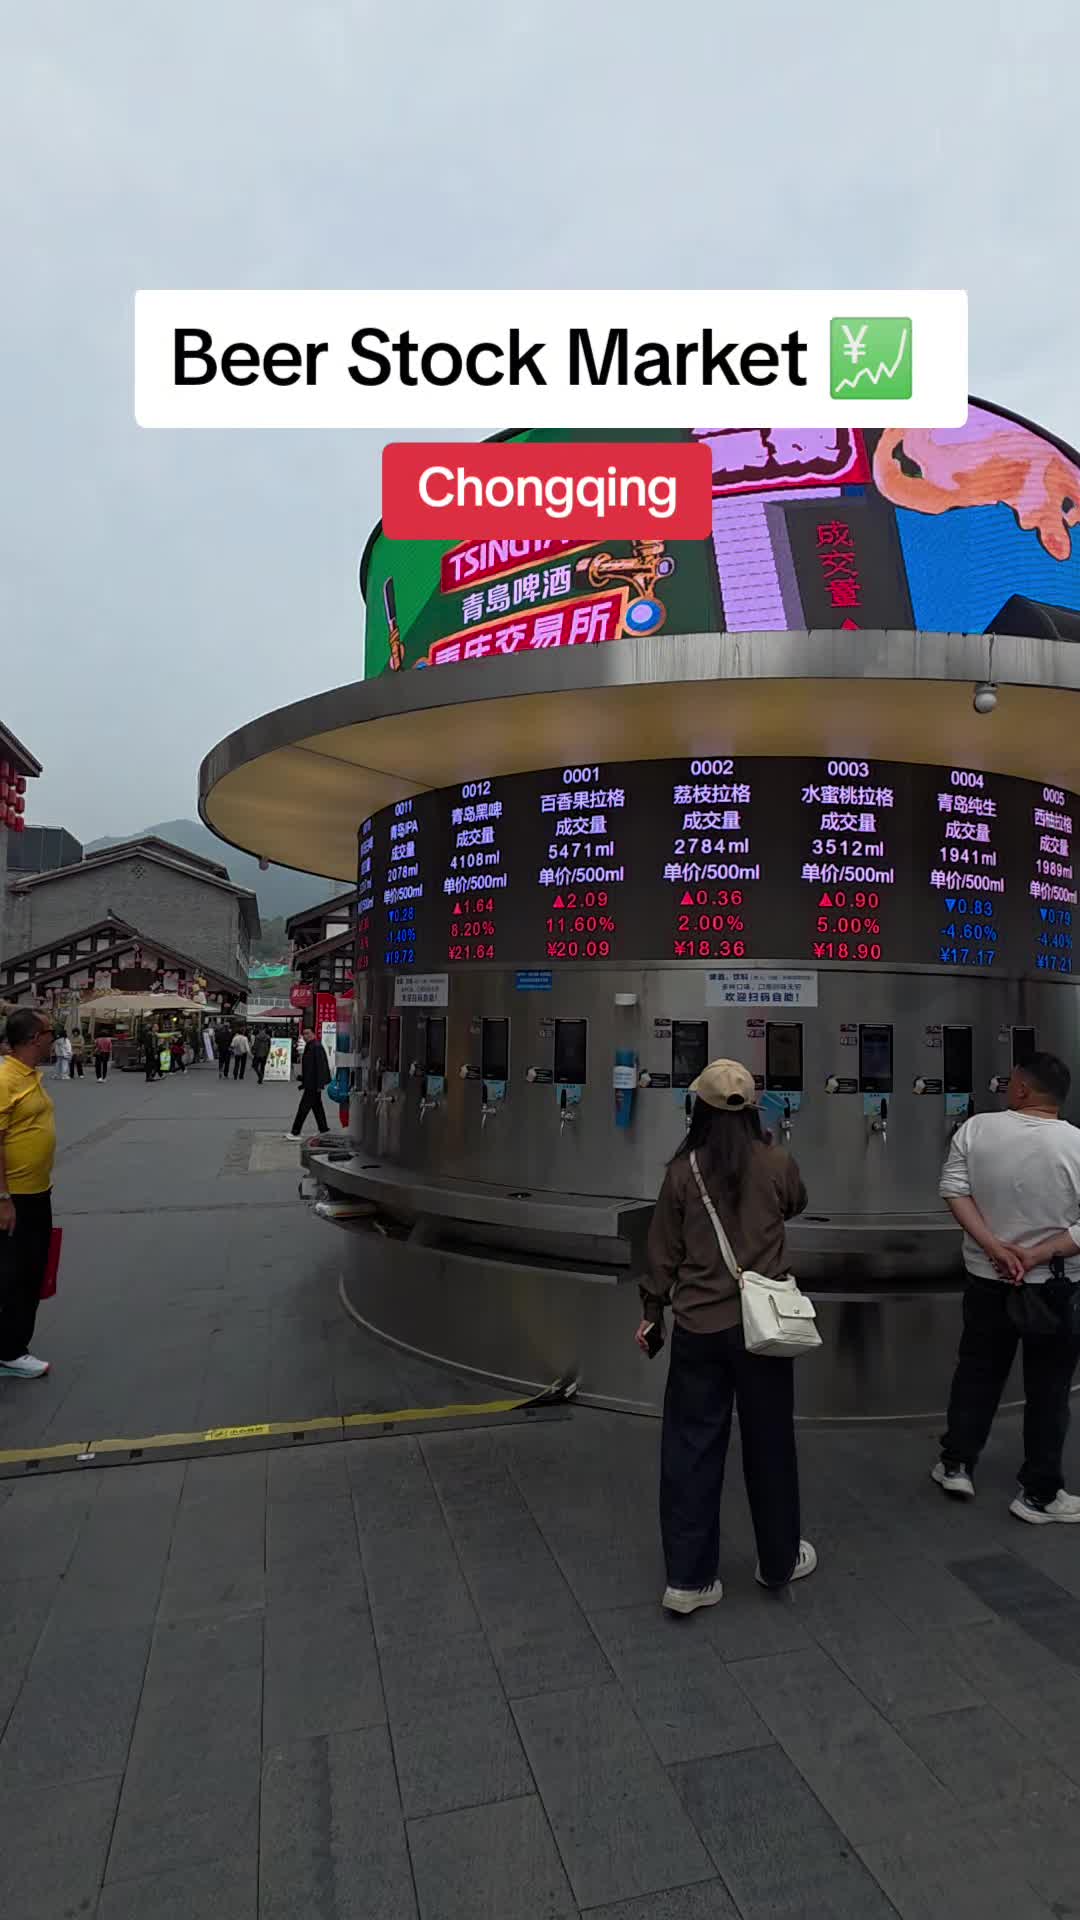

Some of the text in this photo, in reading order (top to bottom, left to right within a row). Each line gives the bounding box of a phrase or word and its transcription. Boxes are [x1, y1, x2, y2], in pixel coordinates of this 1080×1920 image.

[816, 520, 862, 607] 成交量
[462, 564, 571, 624] 青島啤酒
[563, 767, 598, 784] 0001
[691, 760, 733, 776] 0002
[828, 761, 869, 777] 0003
[951, 771, 984, 788] 0004
[461, 781, 490, 798] 0012
[674, 784, 750, 804] 荔枝拉格
[801, 786, 893, 807] 水蜜桃拉格
[1043, 786, 1066, 806] 0005
[395, 801, 412, 816] 0011
[540, 788, 625, 812] 百香果拉格
[937, 793, 996, 817] 青岛纯生
[452, 801, 502, 825] 青岛黑啤
[683, 811, 740, 830] 成交量
[820, 812, 876, 832] 成交量
[556, 815, 607, 836] 成交量
[945, 821, 990, 842] 成交量
[456, 826, 495, 847] 成交量
[1040, 835, 1068, 856] 成交量
[391, 841, 415, 860] 成交量
[549, 841, 614, 859] 5471ml
[675, 838, 748, 854] 2784ml
[813, 839, 883, 856] 3512ml
[450, 851, 499, 869] 4108ml
[940, 847, 996, 866] 1941ml
[388, 863, 418, 882] 2078ml
[539, 866, 624, 886] 单价/500ml
[663, 863, 759, 882] 单价/500ml
[801, 863, 893, 883] 单价/500ml
[1036, 859, 1072, 879] 1989ml
[444, 873, 507, 895] 单价/500ml
[930, 869, 1004, 892] 单价/500ml
[384, 884, 422, 904] 单价/500ml
[567, 892, 607, 908] 2.09
[697, 891, 742, 905] 0.36
[835, 892, 878, 908] 0.90
[1030, 880, 1077, 904] 单价/500ml
[464, 898, 493, 912] 1.64
[958, 899, 992, 916] 0.83
[451, 921, 494, 936] 8.20%
[547, 917, 614, 932] 11.60%
[679, 915, 743, 930] 2.00%
[818, 917, 879, 933] 5.00%
[942, 924, 996, 941] -4.60%
[449, 945, 494, 959] ¥21.64
[548, 941, 609, 957] ¥20.09
[674, 941, 744, 957] ¥18.36
[814, 943, 880, 959] ¥18.90
[940, 948, 994, 964] ¥17.17
